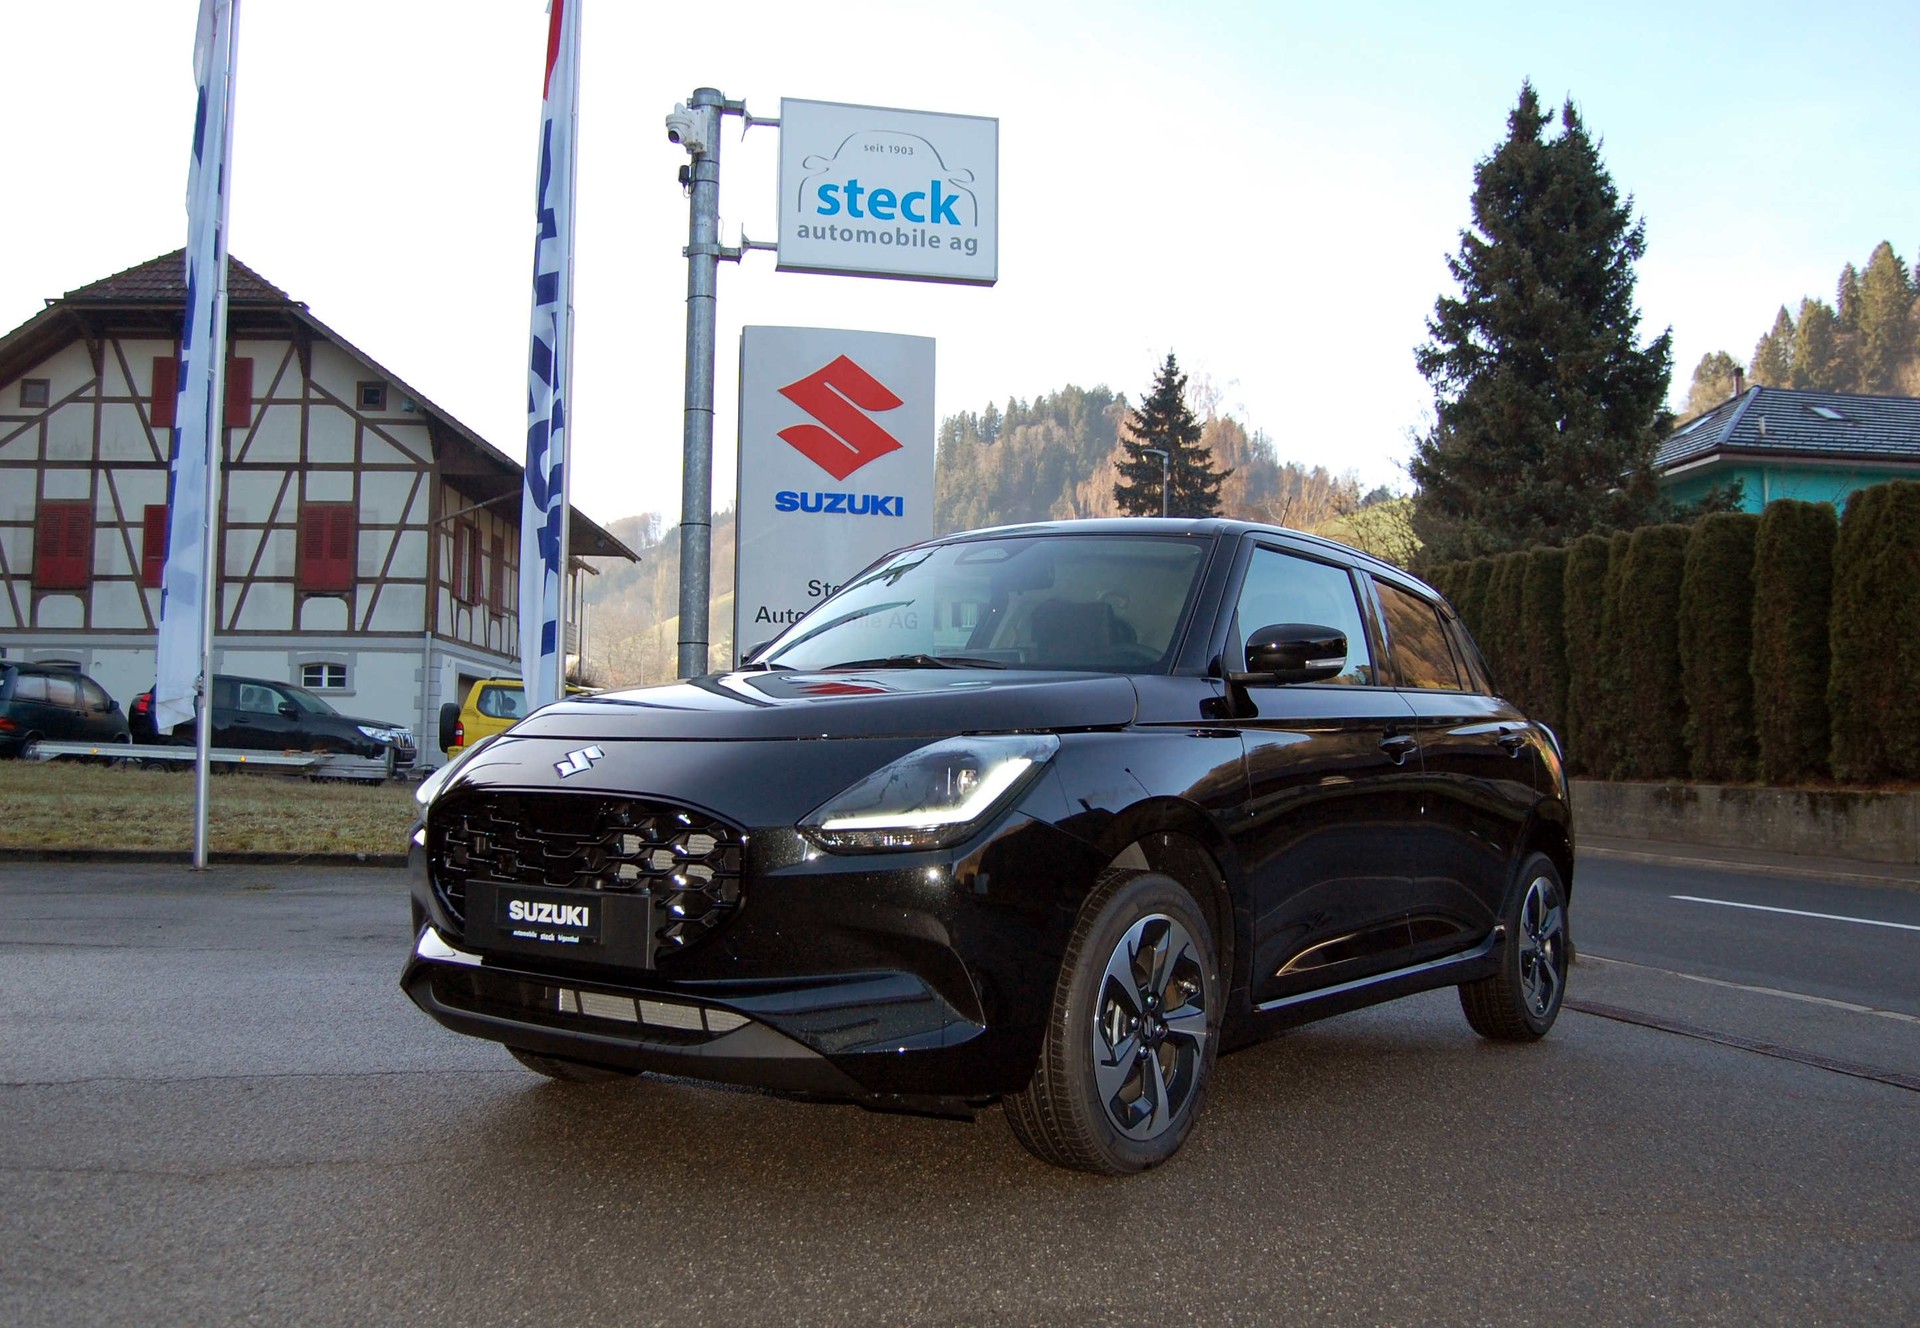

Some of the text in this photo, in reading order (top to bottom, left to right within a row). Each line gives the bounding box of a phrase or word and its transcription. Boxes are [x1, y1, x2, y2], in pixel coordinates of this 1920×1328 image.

[864, 143, 914, 155] seit 1903
[816, 179, 962, 226] steck
[797, 224, 978, 256] automobile ag
[775, 491, 903, 517] SUZUKI
[888, 611, 918, 630] AG
[509, 900, 589, 927] SUZUKI
